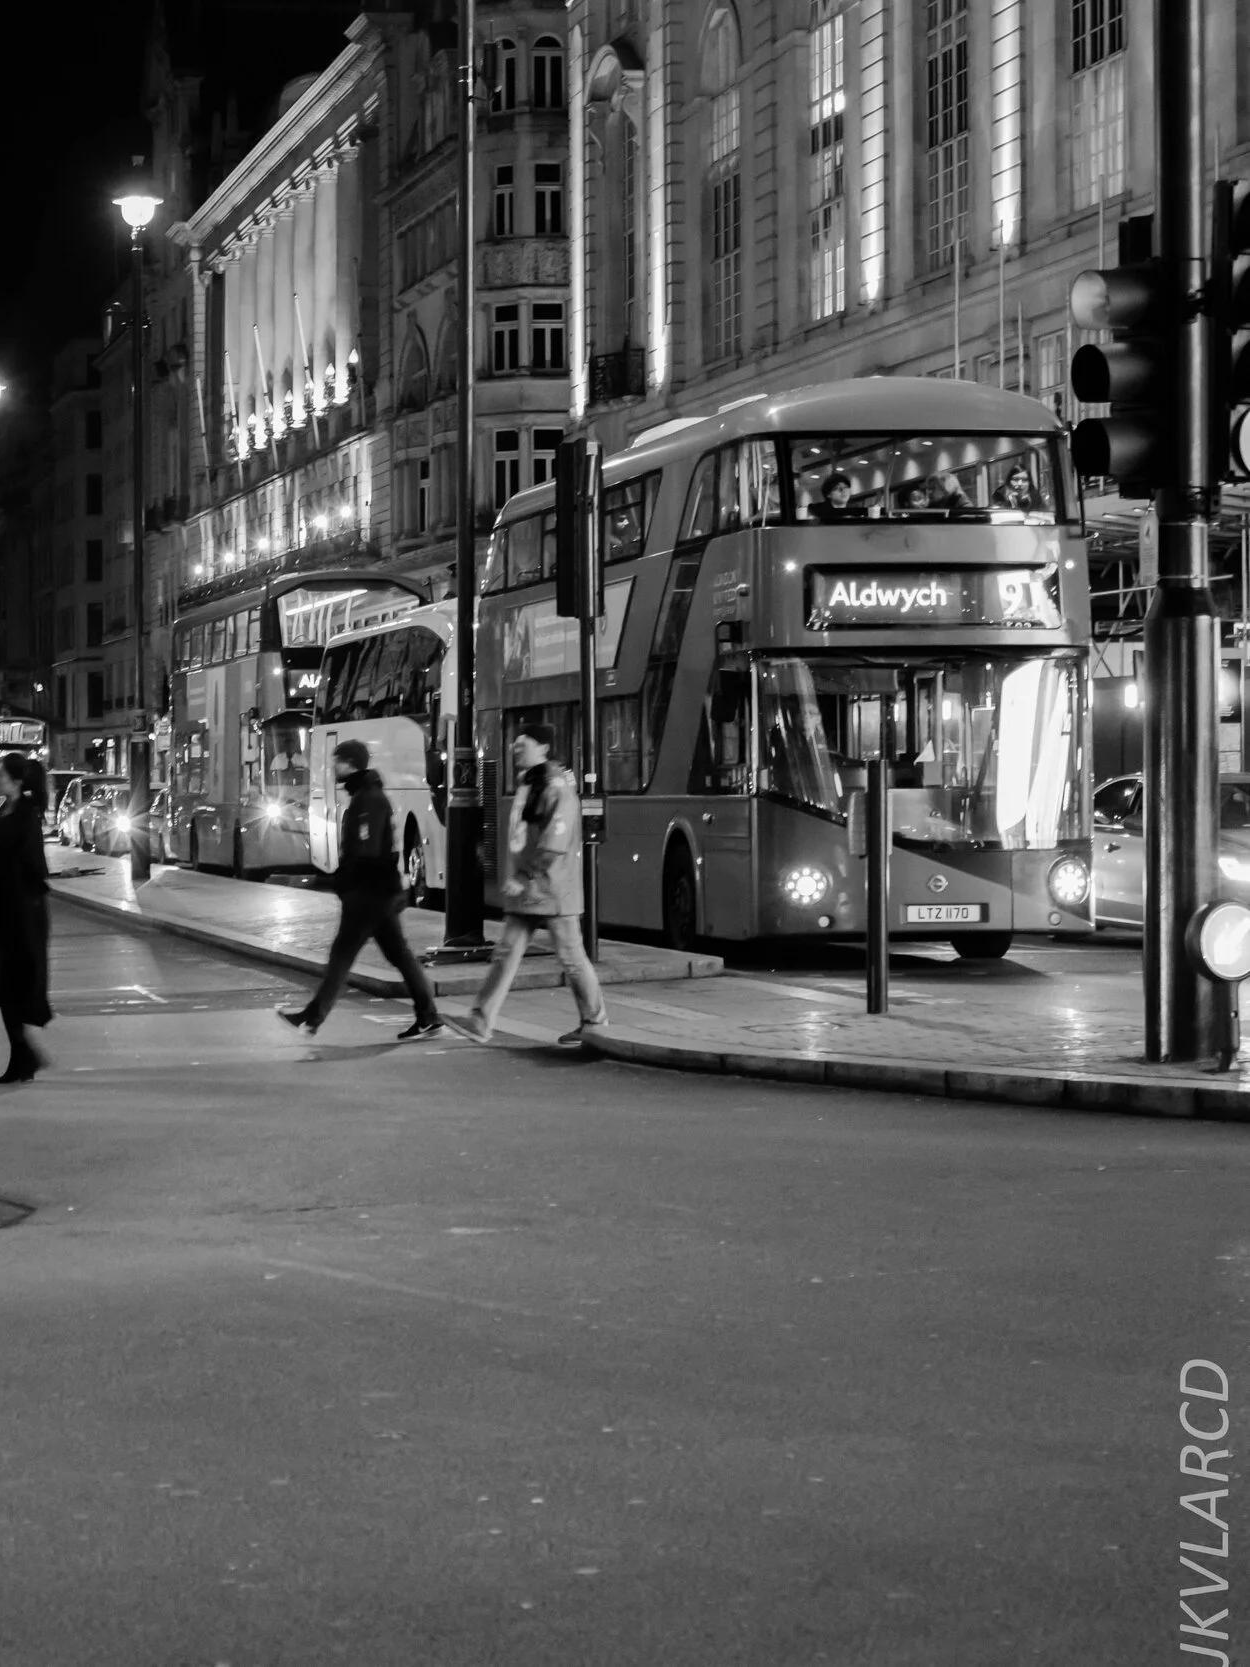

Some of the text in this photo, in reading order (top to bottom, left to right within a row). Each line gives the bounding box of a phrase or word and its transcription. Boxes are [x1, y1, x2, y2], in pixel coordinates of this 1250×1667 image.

[829, 581, 947, 613] Aldwych
[917, 906, 970, 920] LTZ 1170
